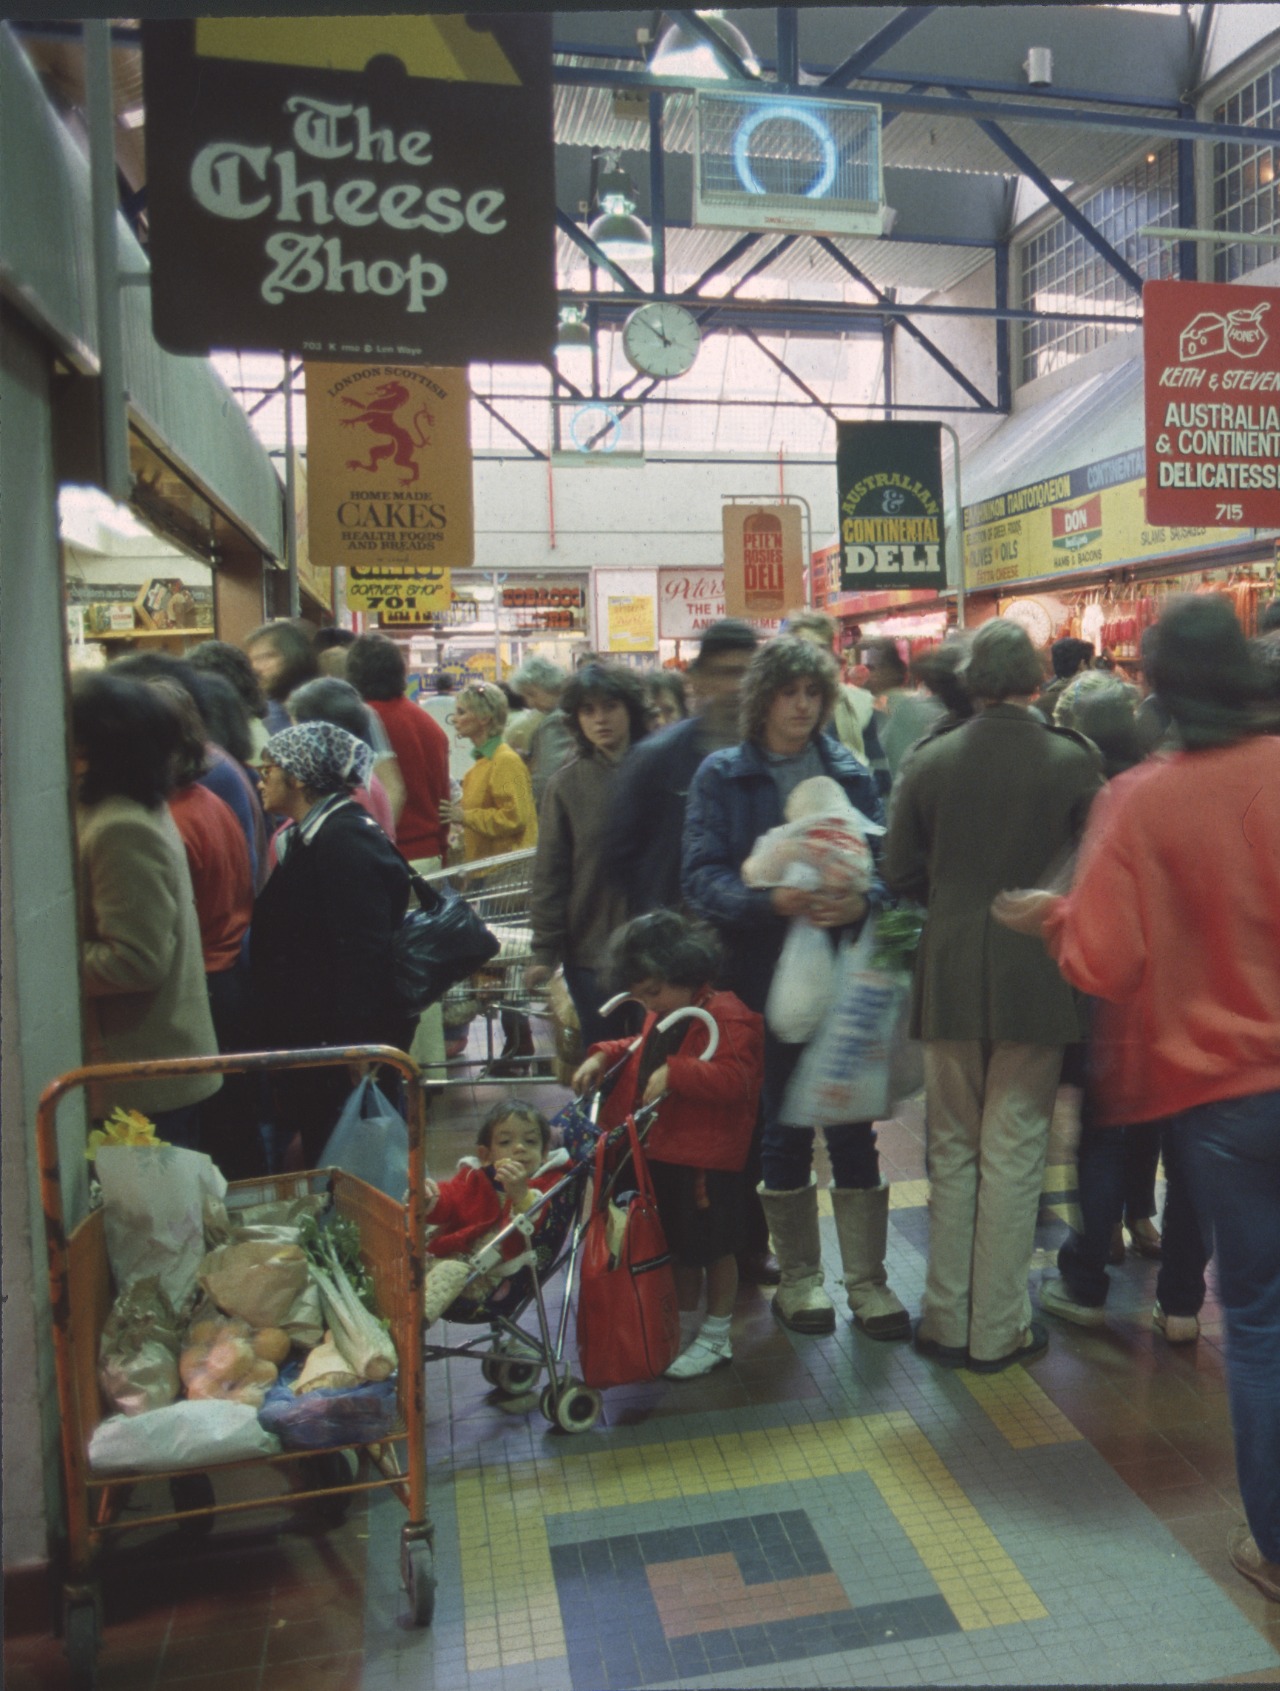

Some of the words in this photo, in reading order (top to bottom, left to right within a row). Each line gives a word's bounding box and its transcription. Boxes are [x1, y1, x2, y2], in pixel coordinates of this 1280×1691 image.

[286, 96, 433, 166] The
[191, 142, 507, 235] Cheese
[261, 232, 448, 313] Shop
[1228, 329, 1261, 343] HONEY
[327, 368, 381, 398] LONDON
[384, 366, 448, 400] SCOTTISH
[1159, 367, 1207, 387] KEITH
[1208, 374, 1219, 391] &
[1155, 434, 1171, 454] &
[393, 491, 433, 500] MADE
[842, 473, 939, 515] AUSTRALIAN
[882, 489, 904, 514] &
[337, 501, 447, 529] CAKES
[1065, 509, 1087, 533] DON
[1215, 504, 1243, 521] 715
[342, 531, 396, 541] HEALTH
[400, 531, 444, 541] FOODS
[842, 517, 940, 544] CONTINENTAL
[347, 541, 378, 551] AND
[381, 541, 436, 551] BREADS
[1000, 539, 1018, 562] OILS
[844, 544, 941, 574] DELI
[744, 564, 784, 590] DELI
[406, 584, 443, 596] SHOP
[366, 597, 417, 609] 701
[686, 603, 711, 615] THE
